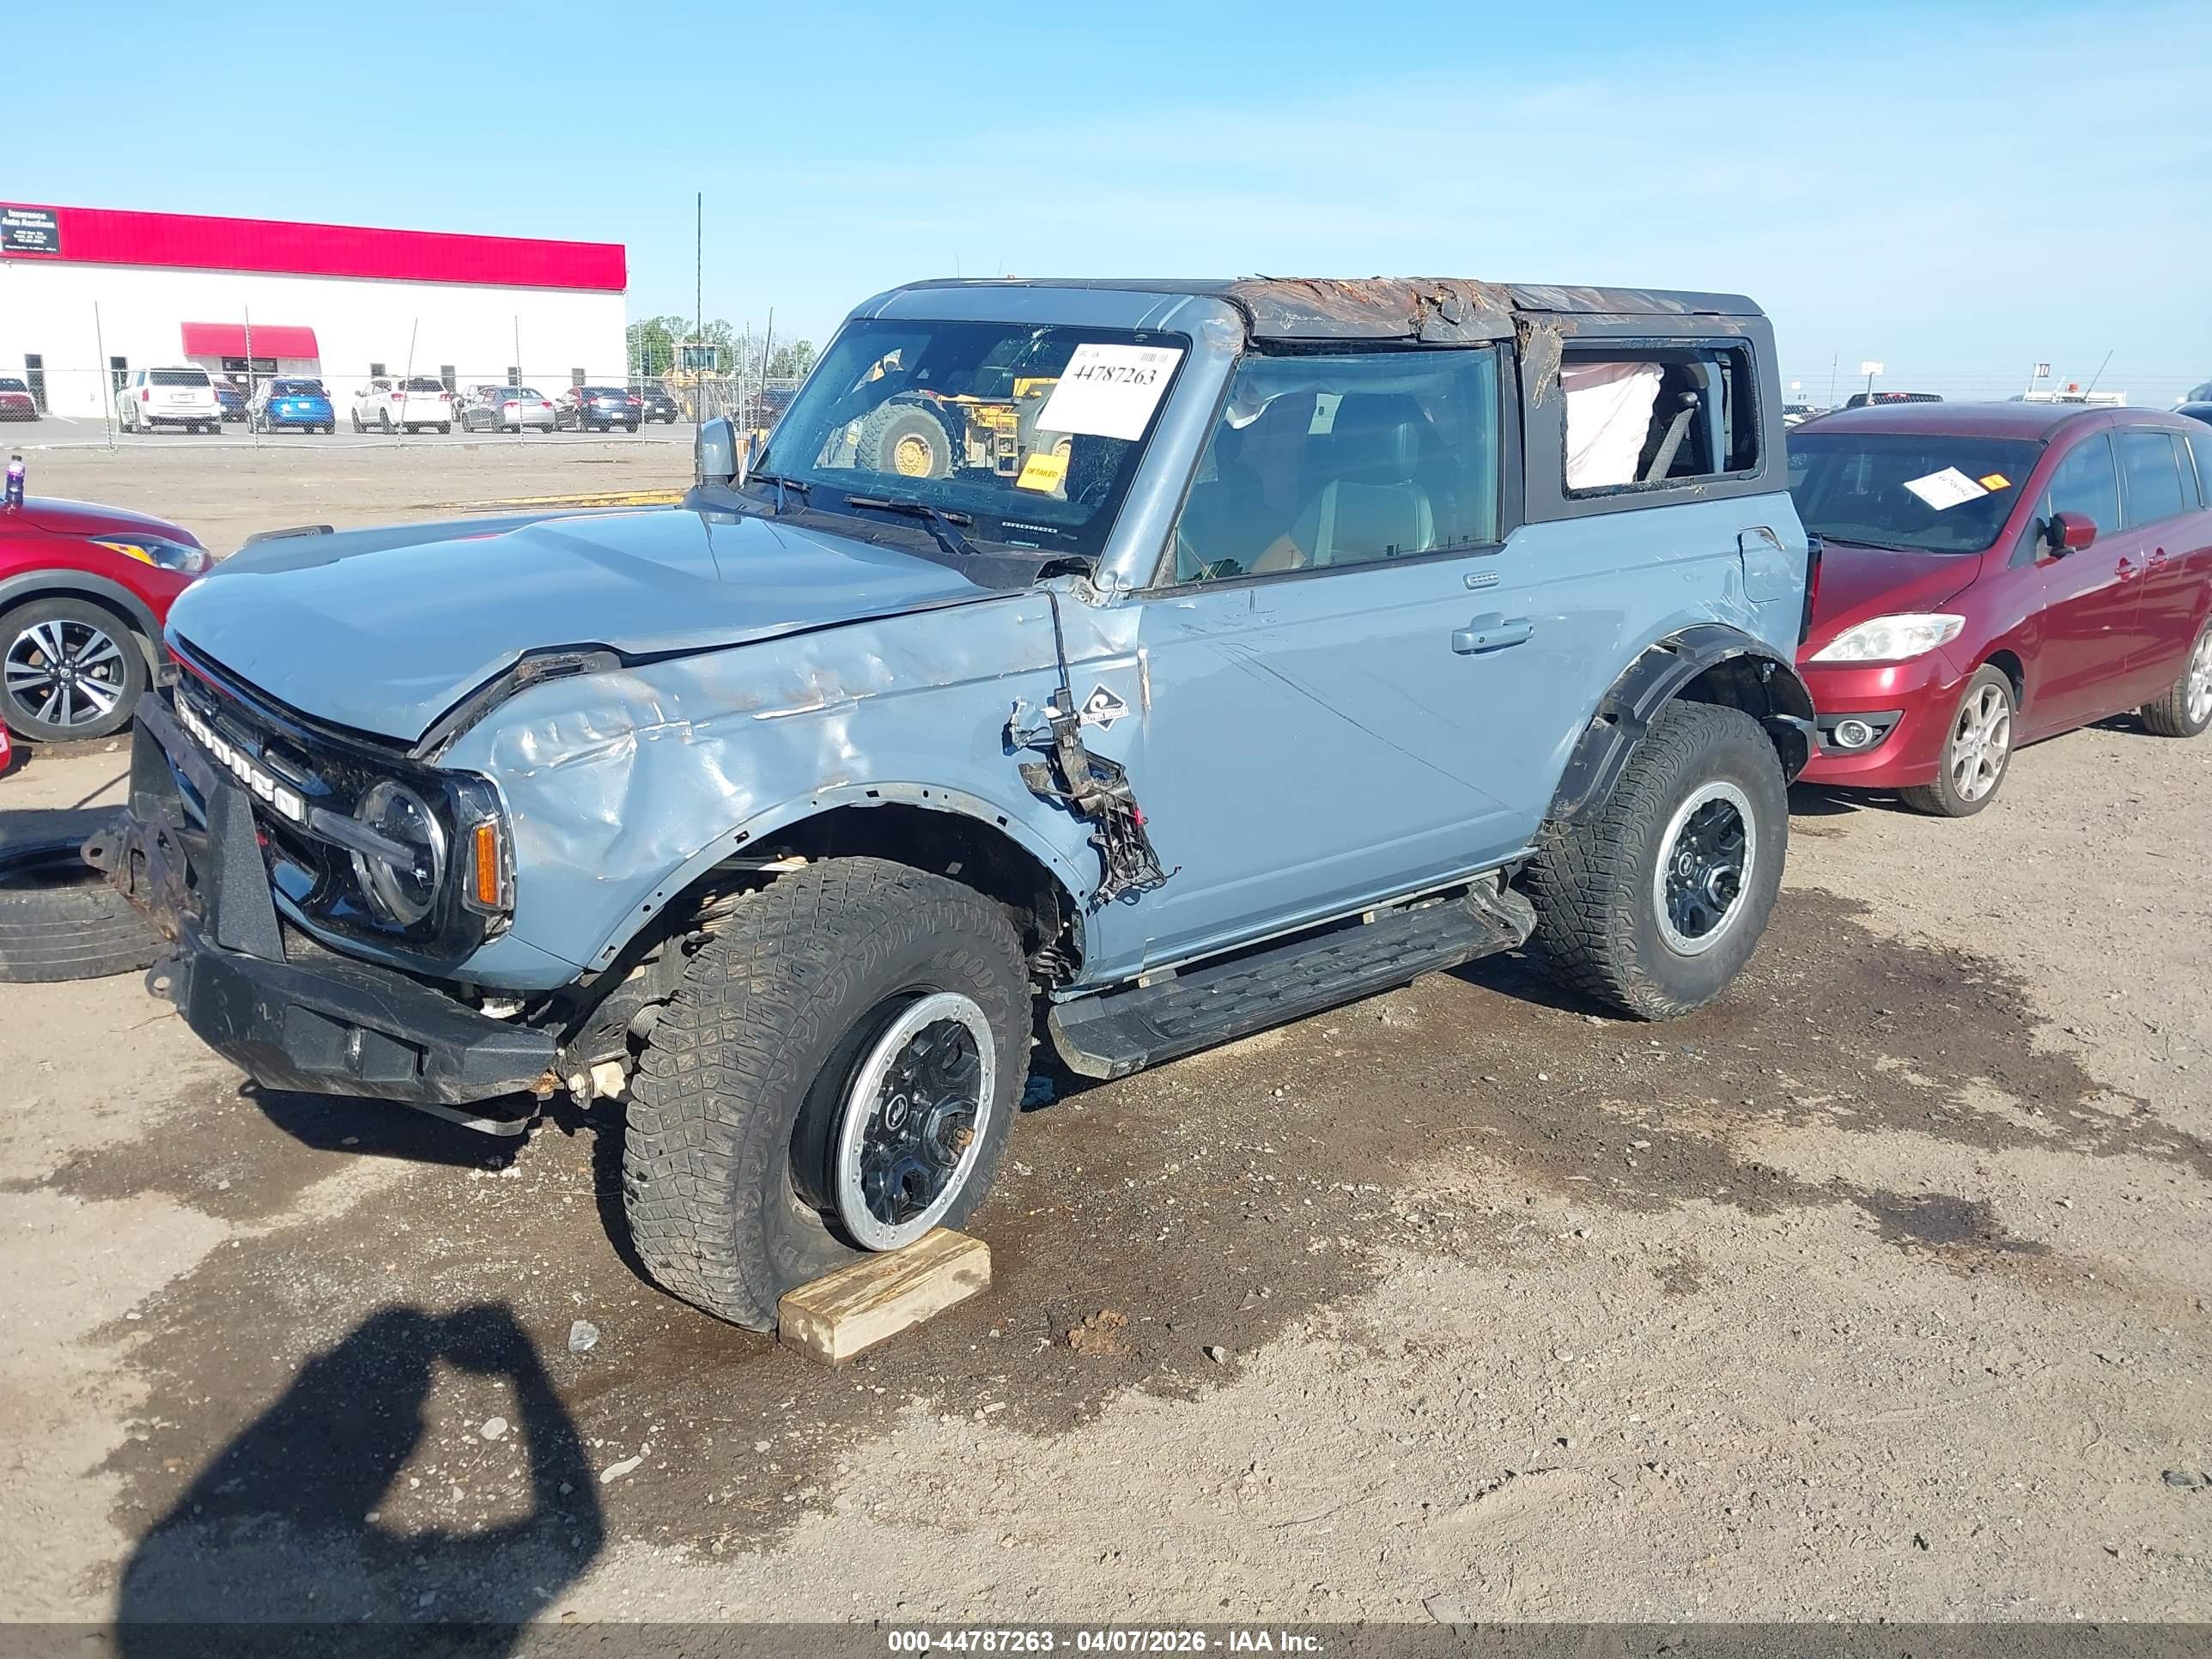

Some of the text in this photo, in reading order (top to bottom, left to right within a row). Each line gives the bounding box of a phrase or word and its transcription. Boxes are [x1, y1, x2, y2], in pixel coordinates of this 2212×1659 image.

[2, 217, 21, 226] Auto
[1073, 364, 1157, 385] 44787263
[1026, 468, 1058, 477] DETAILED
[1001, 521, 1058, 534] BRONCO
